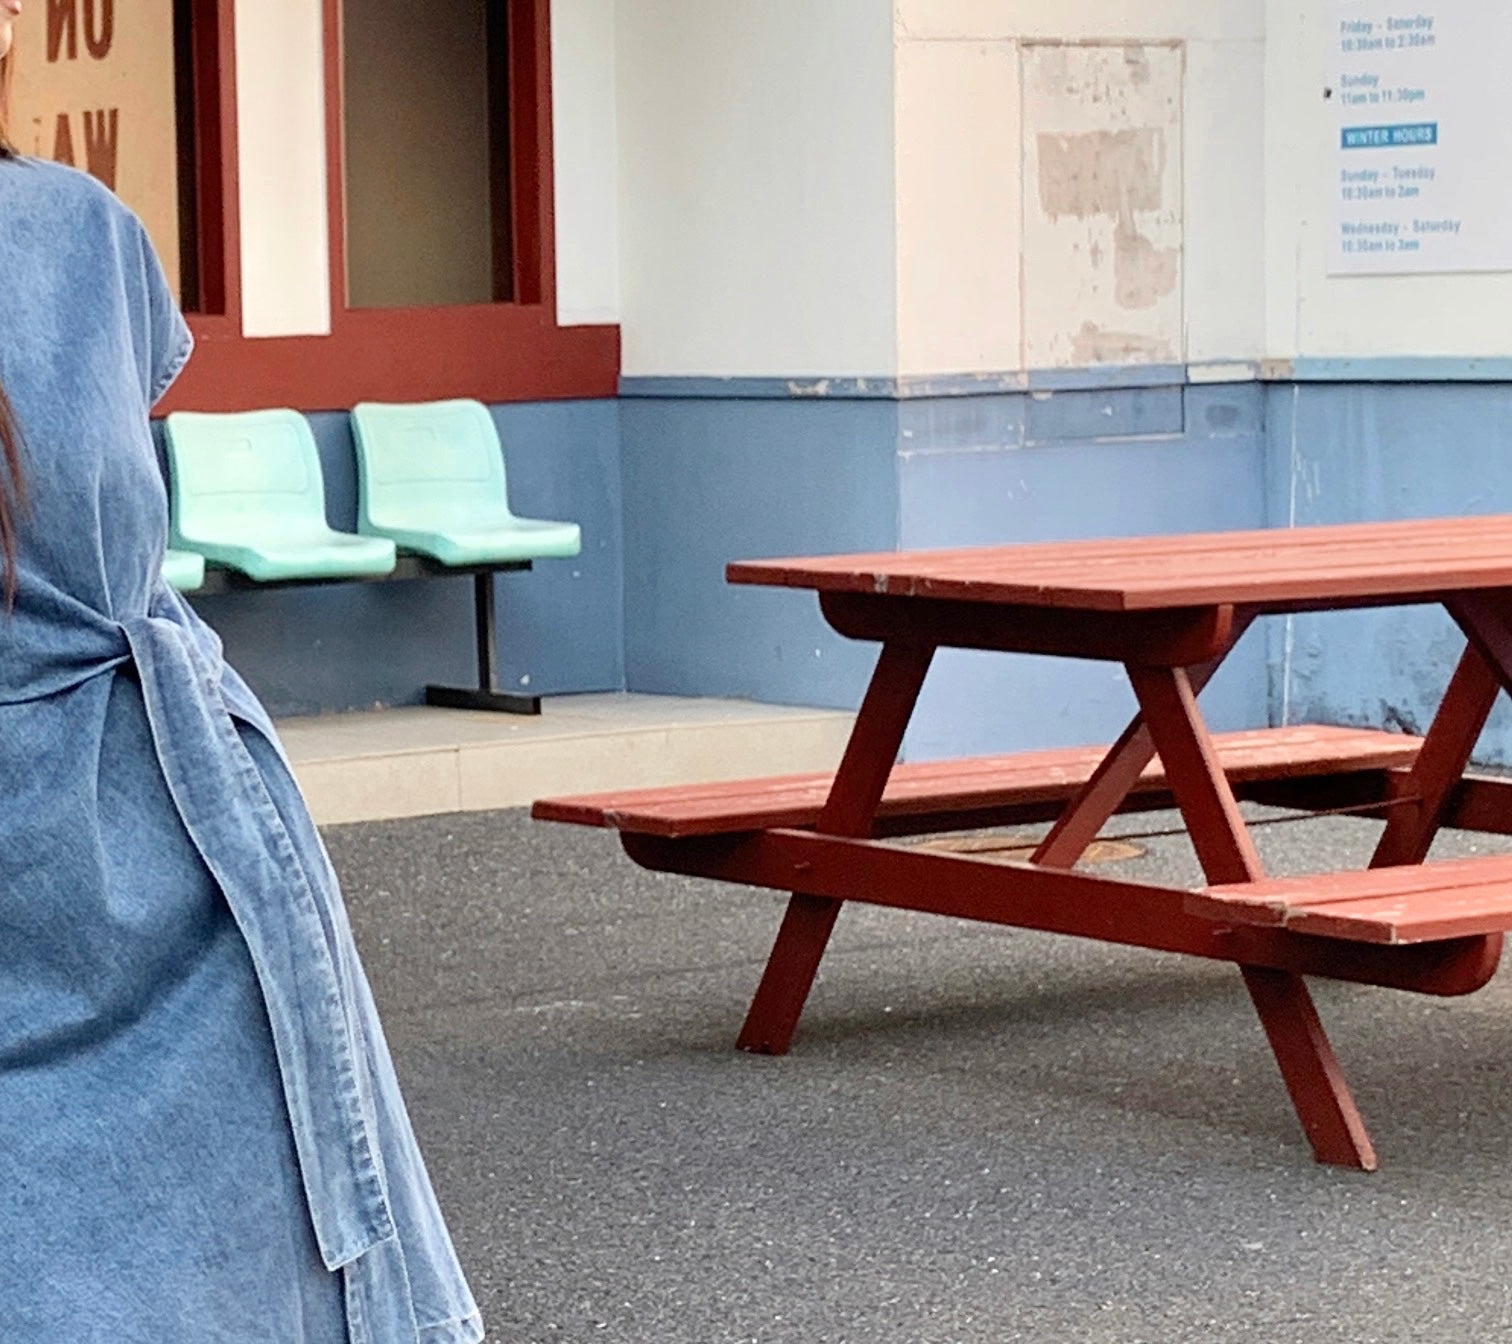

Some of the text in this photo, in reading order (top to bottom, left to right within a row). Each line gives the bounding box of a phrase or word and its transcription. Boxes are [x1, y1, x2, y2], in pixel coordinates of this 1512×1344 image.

[1340, 18, 1373, 34] Friday
[1386, 14, 1434, 31] Saturday
[1340, 72, 1380, 89] Sunday
[1345, 127, 1433, 145] WINTER HOURS
[1340, 167, 1379, 183] Sunday
[1392, 164, 1436, 181] Tuesday
[1340, 221, 1400, 236] Wednesday
[1413, 217, 1462, 234] Saturday
